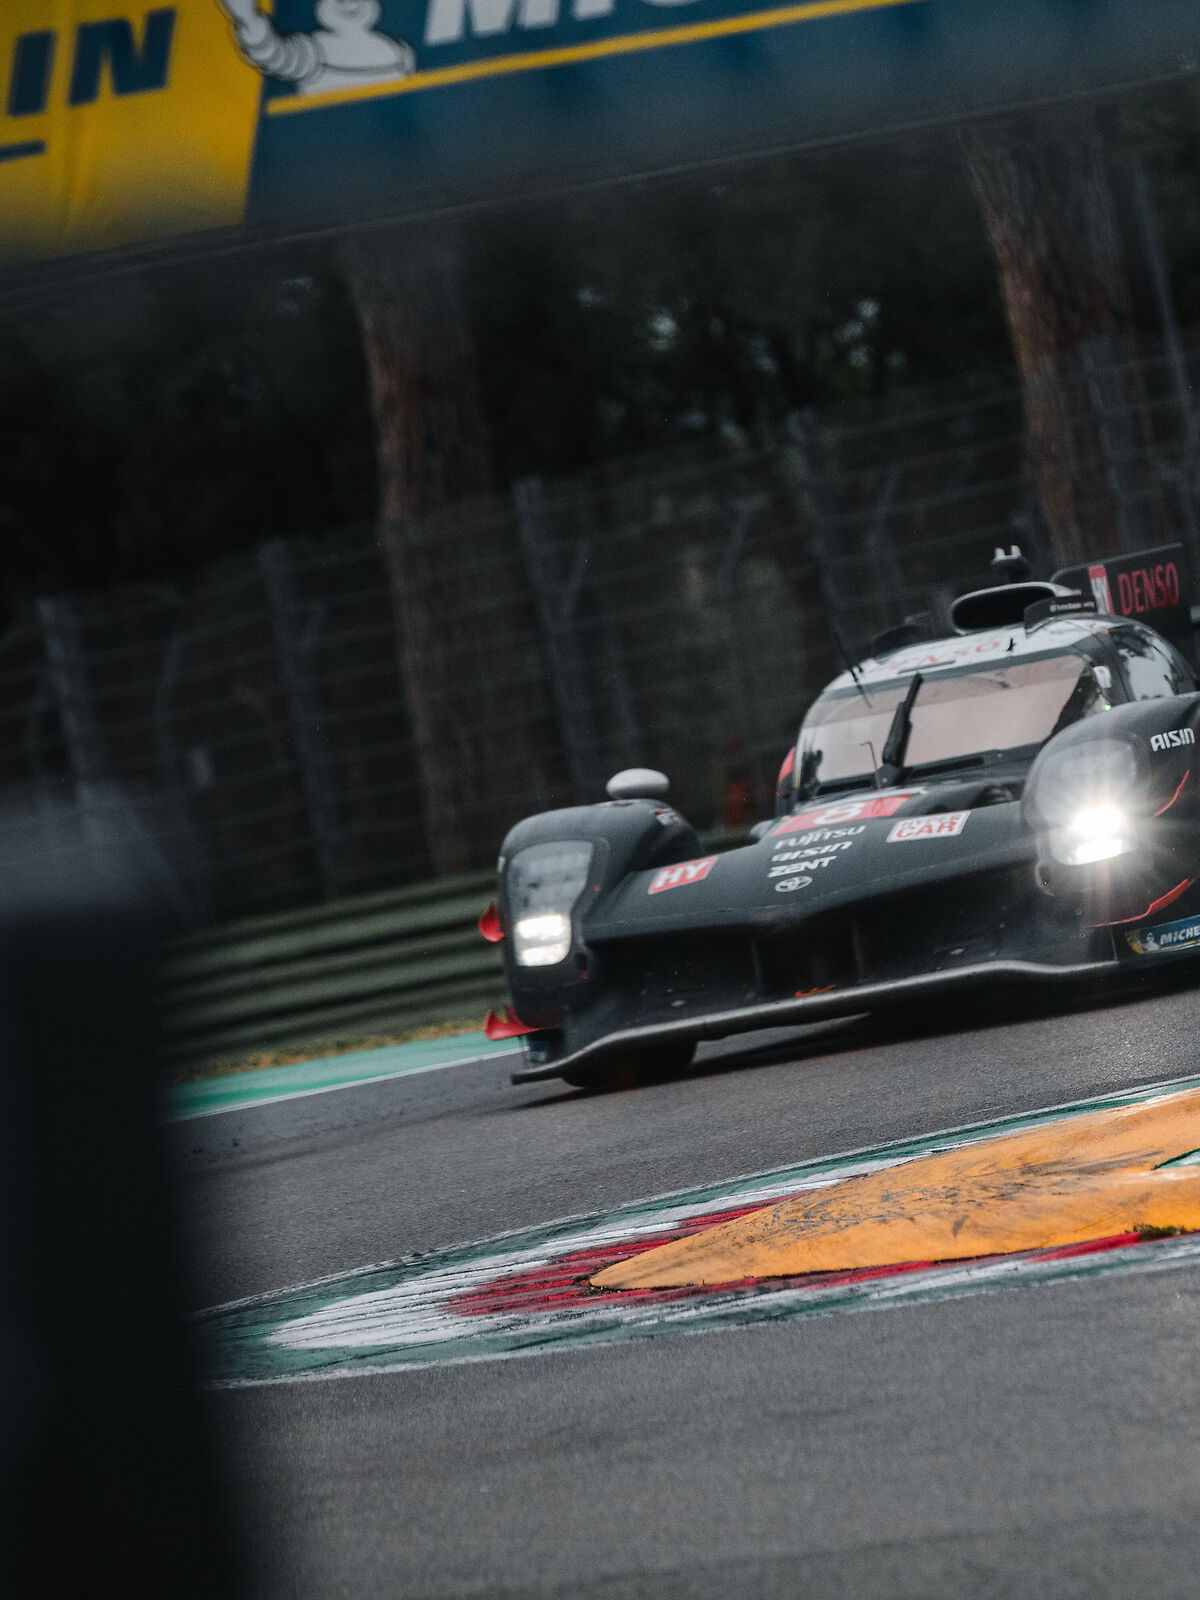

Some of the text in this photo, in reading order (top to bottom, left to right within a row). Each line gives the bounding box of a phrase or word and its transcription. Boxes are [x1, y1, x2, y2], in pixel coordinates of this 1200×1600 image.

[1117, 562, 1180, 616] DENSO
[1150, 727, 1196, 752] AISIN
[813, 802, 867, 824] 8
[774, 824, 866, 850] FUJITSU
[896, 821, 957, 838] CAR
[655, 861, 711, 888] HY
[767, 855, 838, 878] ZENT
